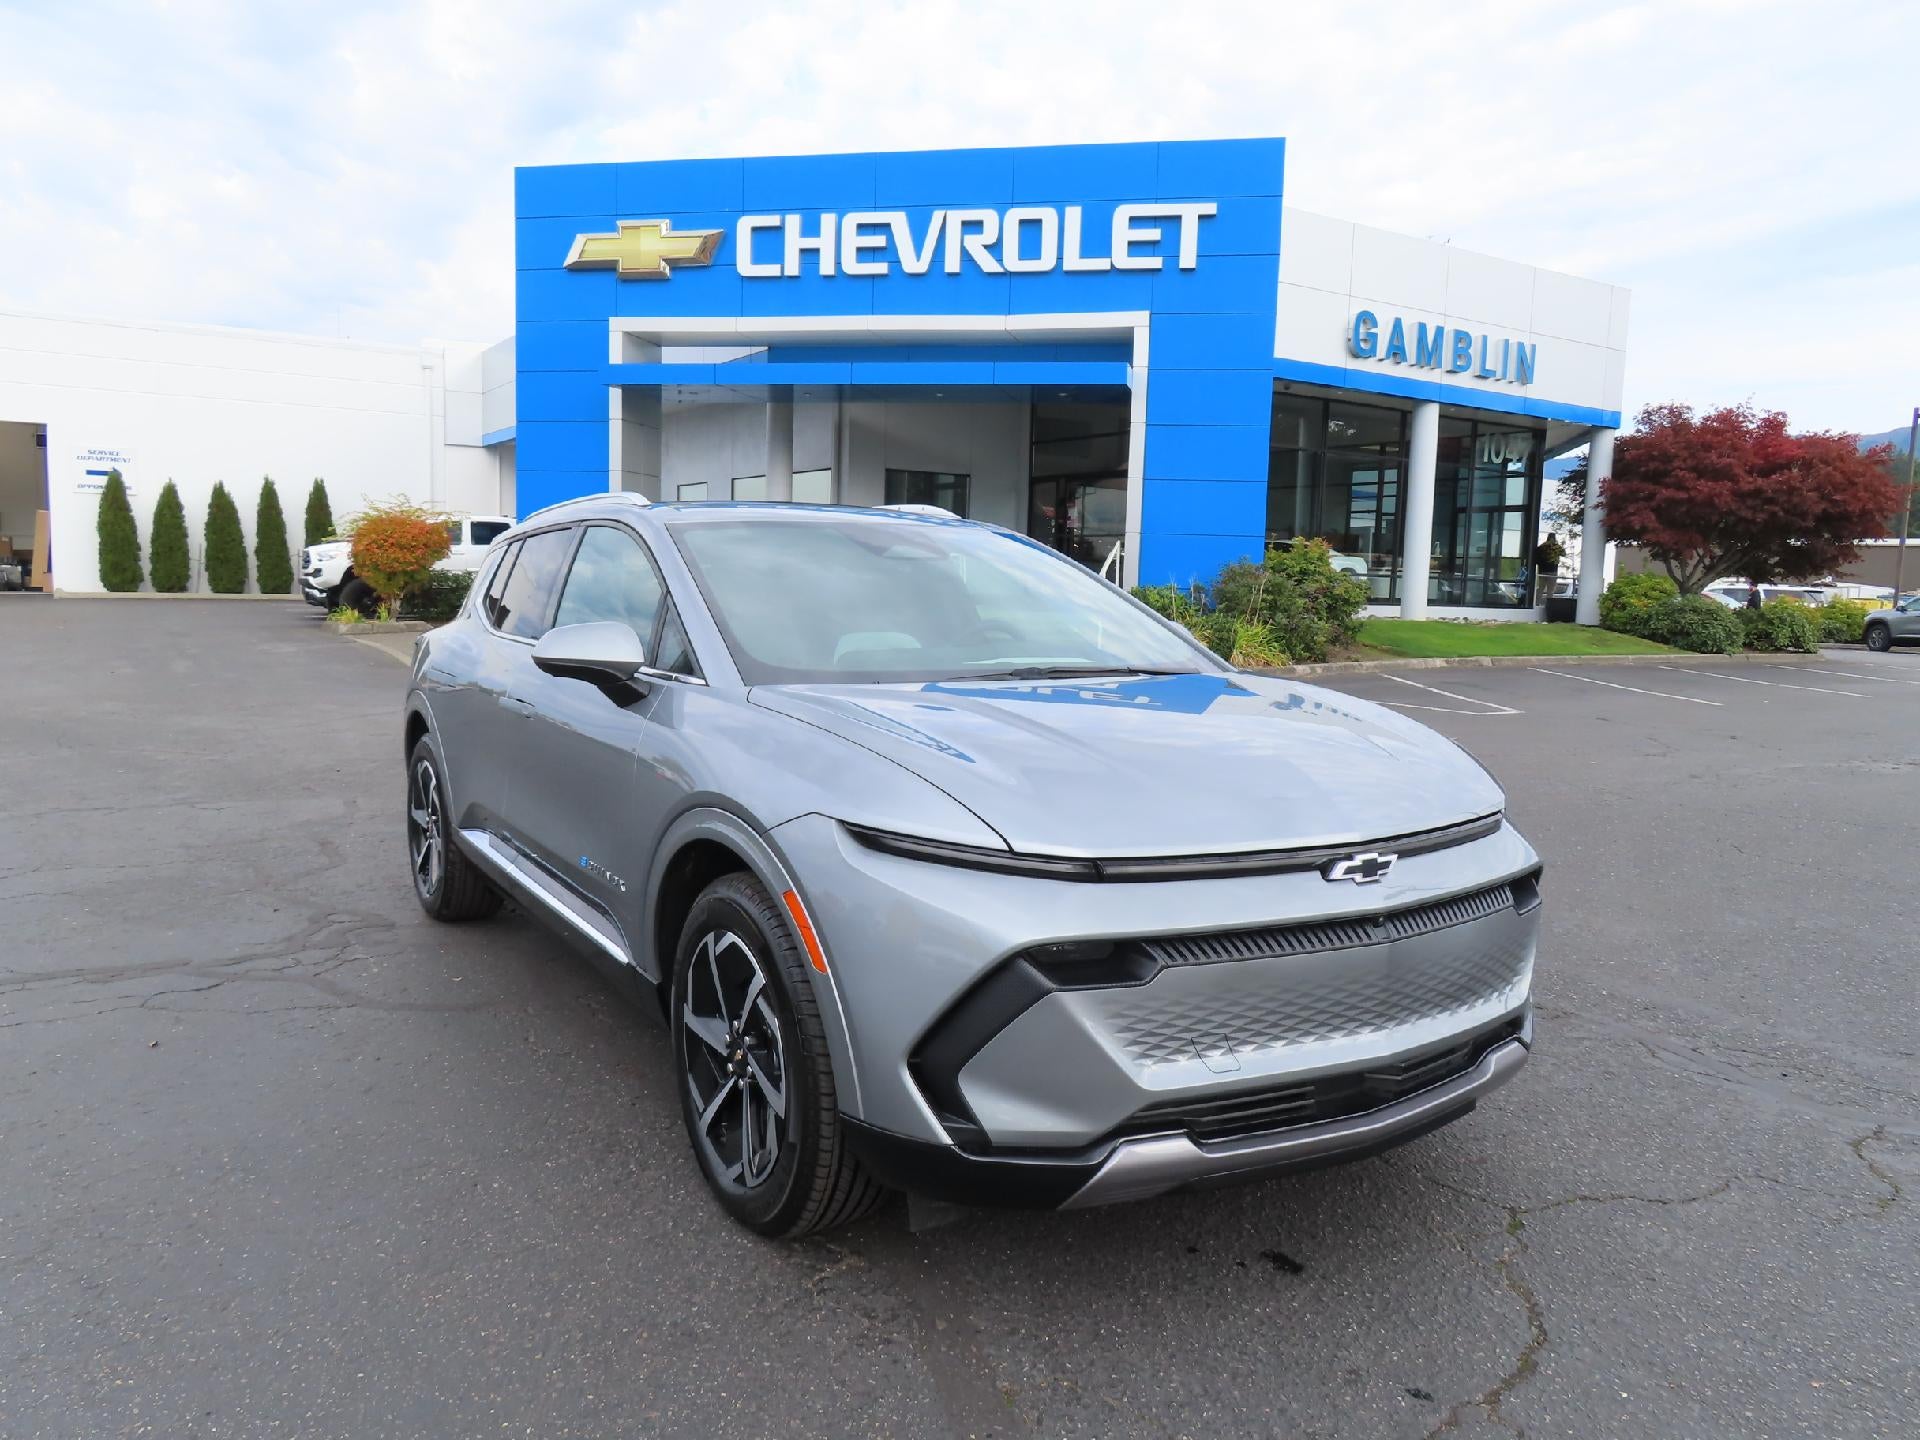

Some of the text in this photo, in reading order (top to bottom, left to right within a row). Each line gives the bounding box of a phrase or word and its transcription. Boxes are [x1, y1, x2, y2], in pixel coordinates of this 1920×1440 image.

[736, 202, 1218, 278] CHEVROLET
[1350, 310, 1537, 386] GAMBLIN
[76, 455, 131, 463] DEPARTMENT
[87, 449, 120, 457] SERVICE
